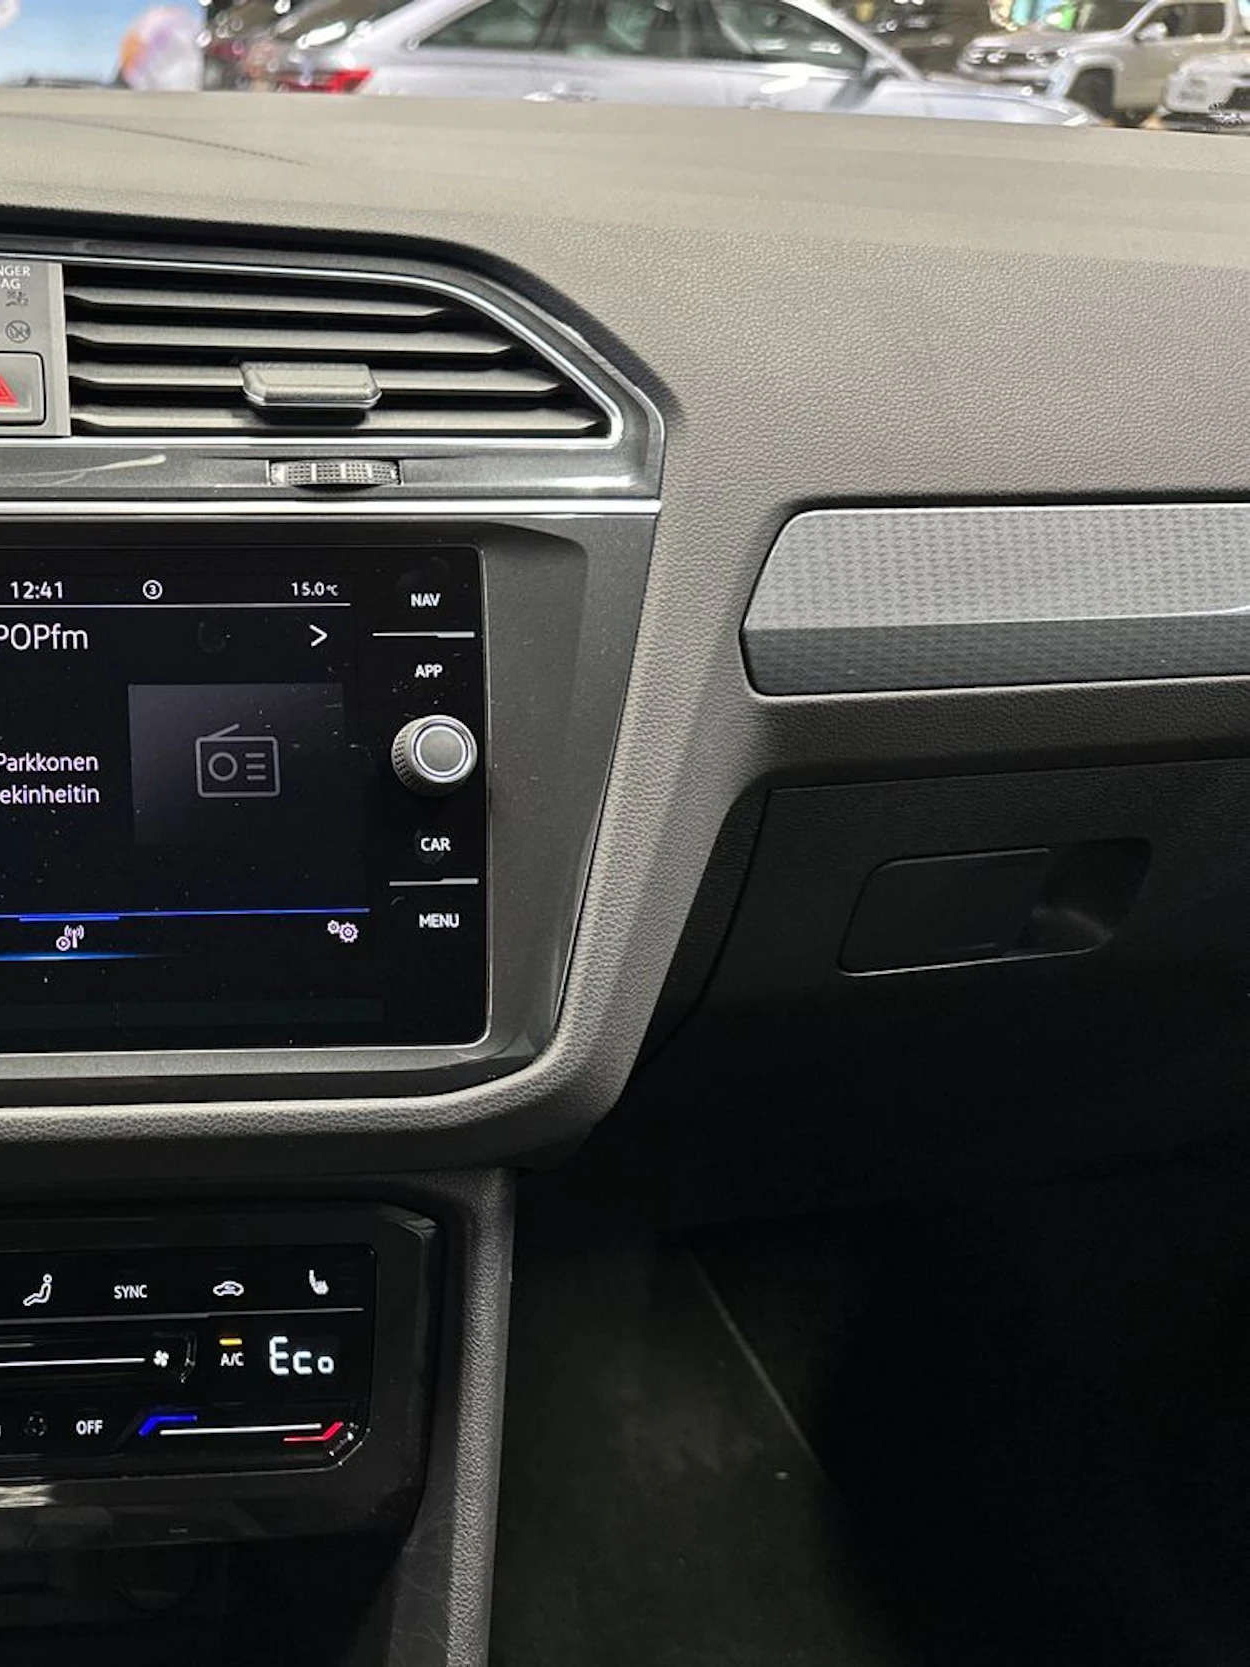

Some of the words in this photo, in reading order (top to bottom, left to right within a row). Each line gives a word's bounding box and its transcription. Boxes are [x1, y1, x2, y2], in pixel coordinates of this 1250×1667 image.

[11, 582, 62, 599] 12:41
[411, 593, 440, 606] NAV
[415, 664, 442, 677] APP
[421, 838, 450, 851] CAR
[419, 913, 459, 928] MENU
[114, 1285, 147, 1299] SYNC
[221, 1352, 244, 1366] A/C
[269, 1336, 334, 1375] Eco
[76, 1420, 102, 1435] OFF
